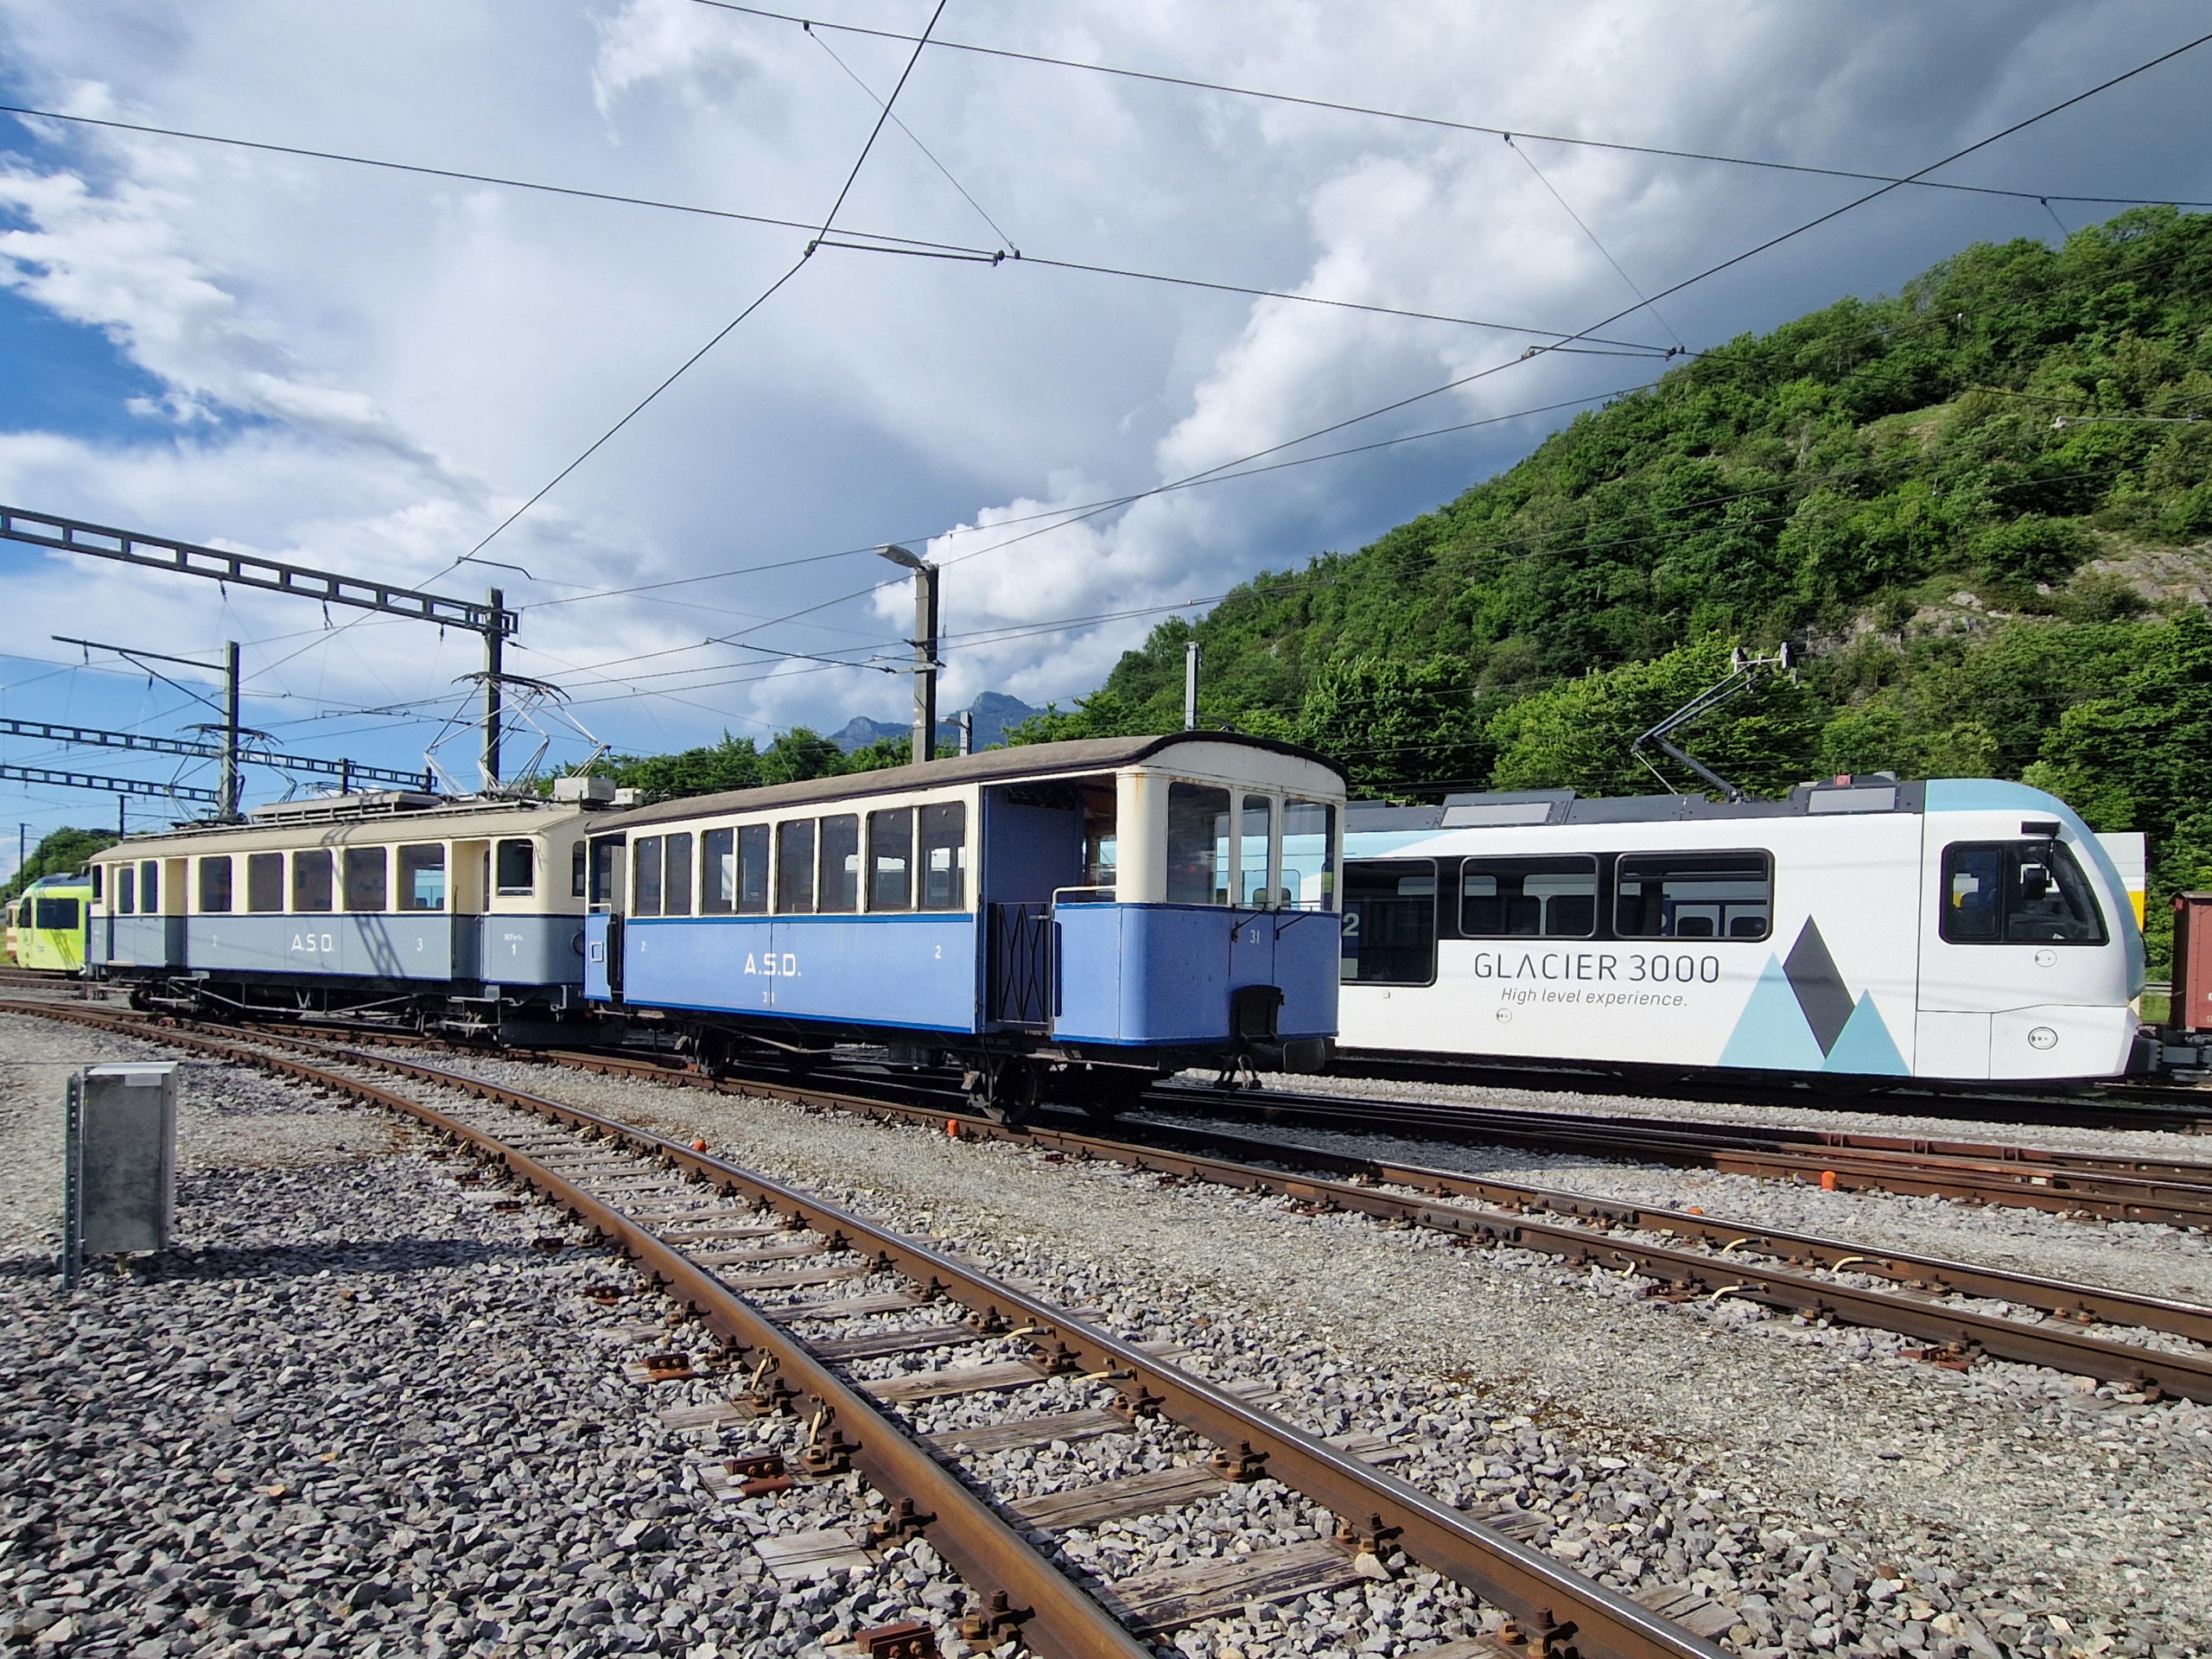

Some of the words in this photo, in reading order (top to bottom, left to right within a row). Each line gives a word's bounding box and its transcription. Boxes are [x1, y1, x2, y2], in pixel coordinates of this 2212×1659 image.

[1342, 912, 1360, 937] 2
[416, 938, 423, 951] 3
[1249, 930, 1260, 944] 31
[512, 943, 516, 957] 1
[935, 944, 941, 958] 2
[744, 952, 802, 976] A.S.D.
[1474, 952, 1617, 981] GLACIER
[1629, 955, 1719, 983] 3000
[1501, 988, 1537, 1005] High
[1541, 988, 1580, 1003] level
[1586, 990, 1688, 1008] experience.
